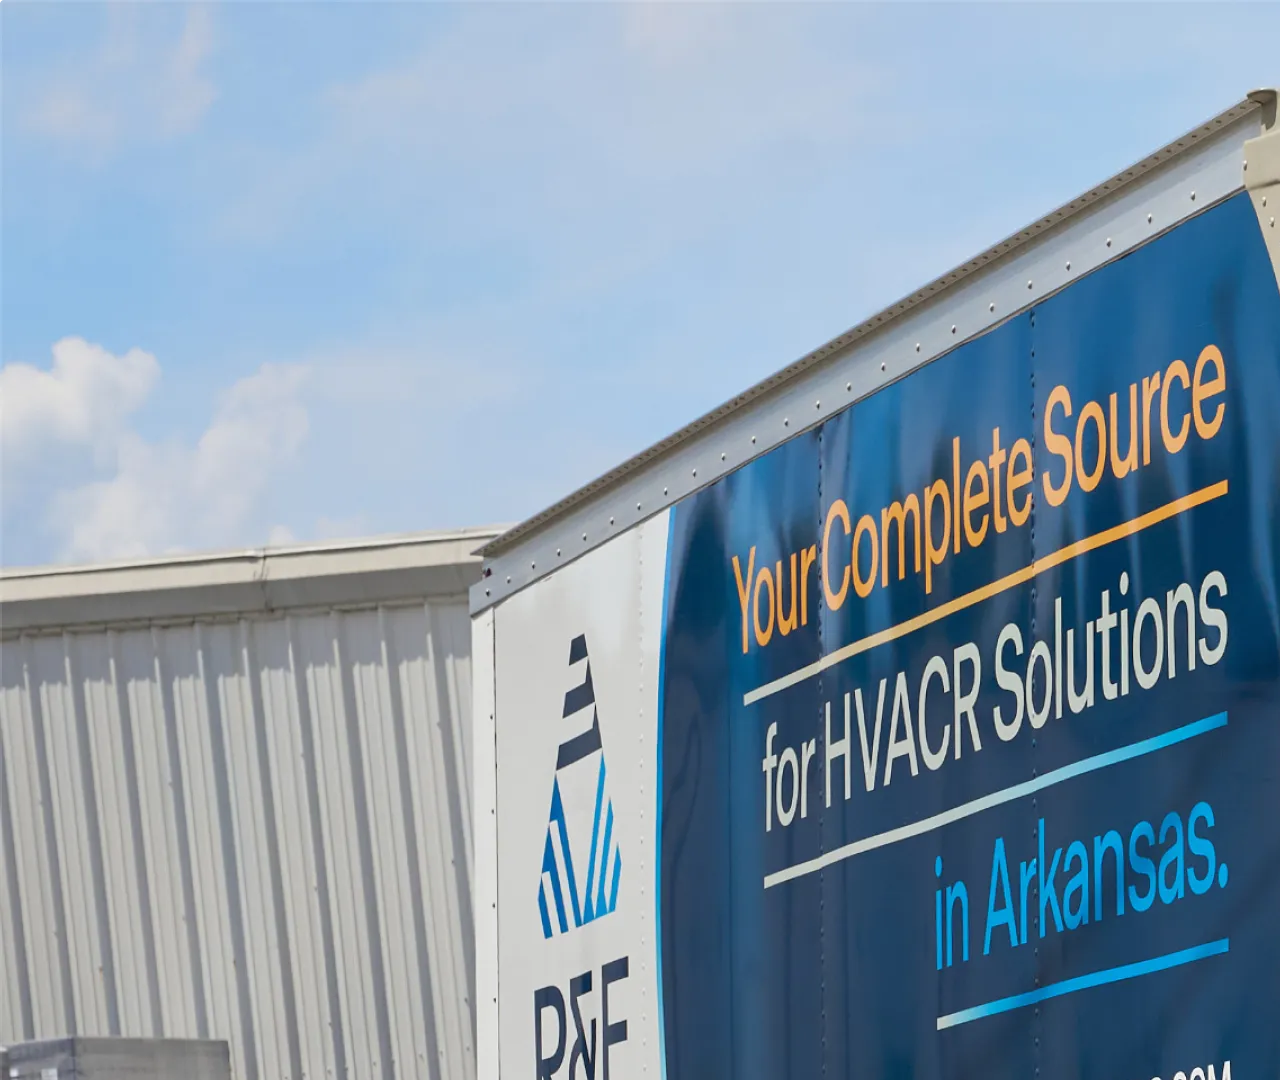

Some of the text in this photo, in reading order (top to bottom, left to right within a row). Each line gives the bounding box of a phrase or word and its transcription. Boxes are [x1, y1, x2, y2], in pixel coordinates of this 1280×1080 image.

[732, 344, 1226, 654] Your Complete Source
[762, 570, 1228, 832] for HVACR Solutions
[935, 801, 1229, 970] in Arkansas.
